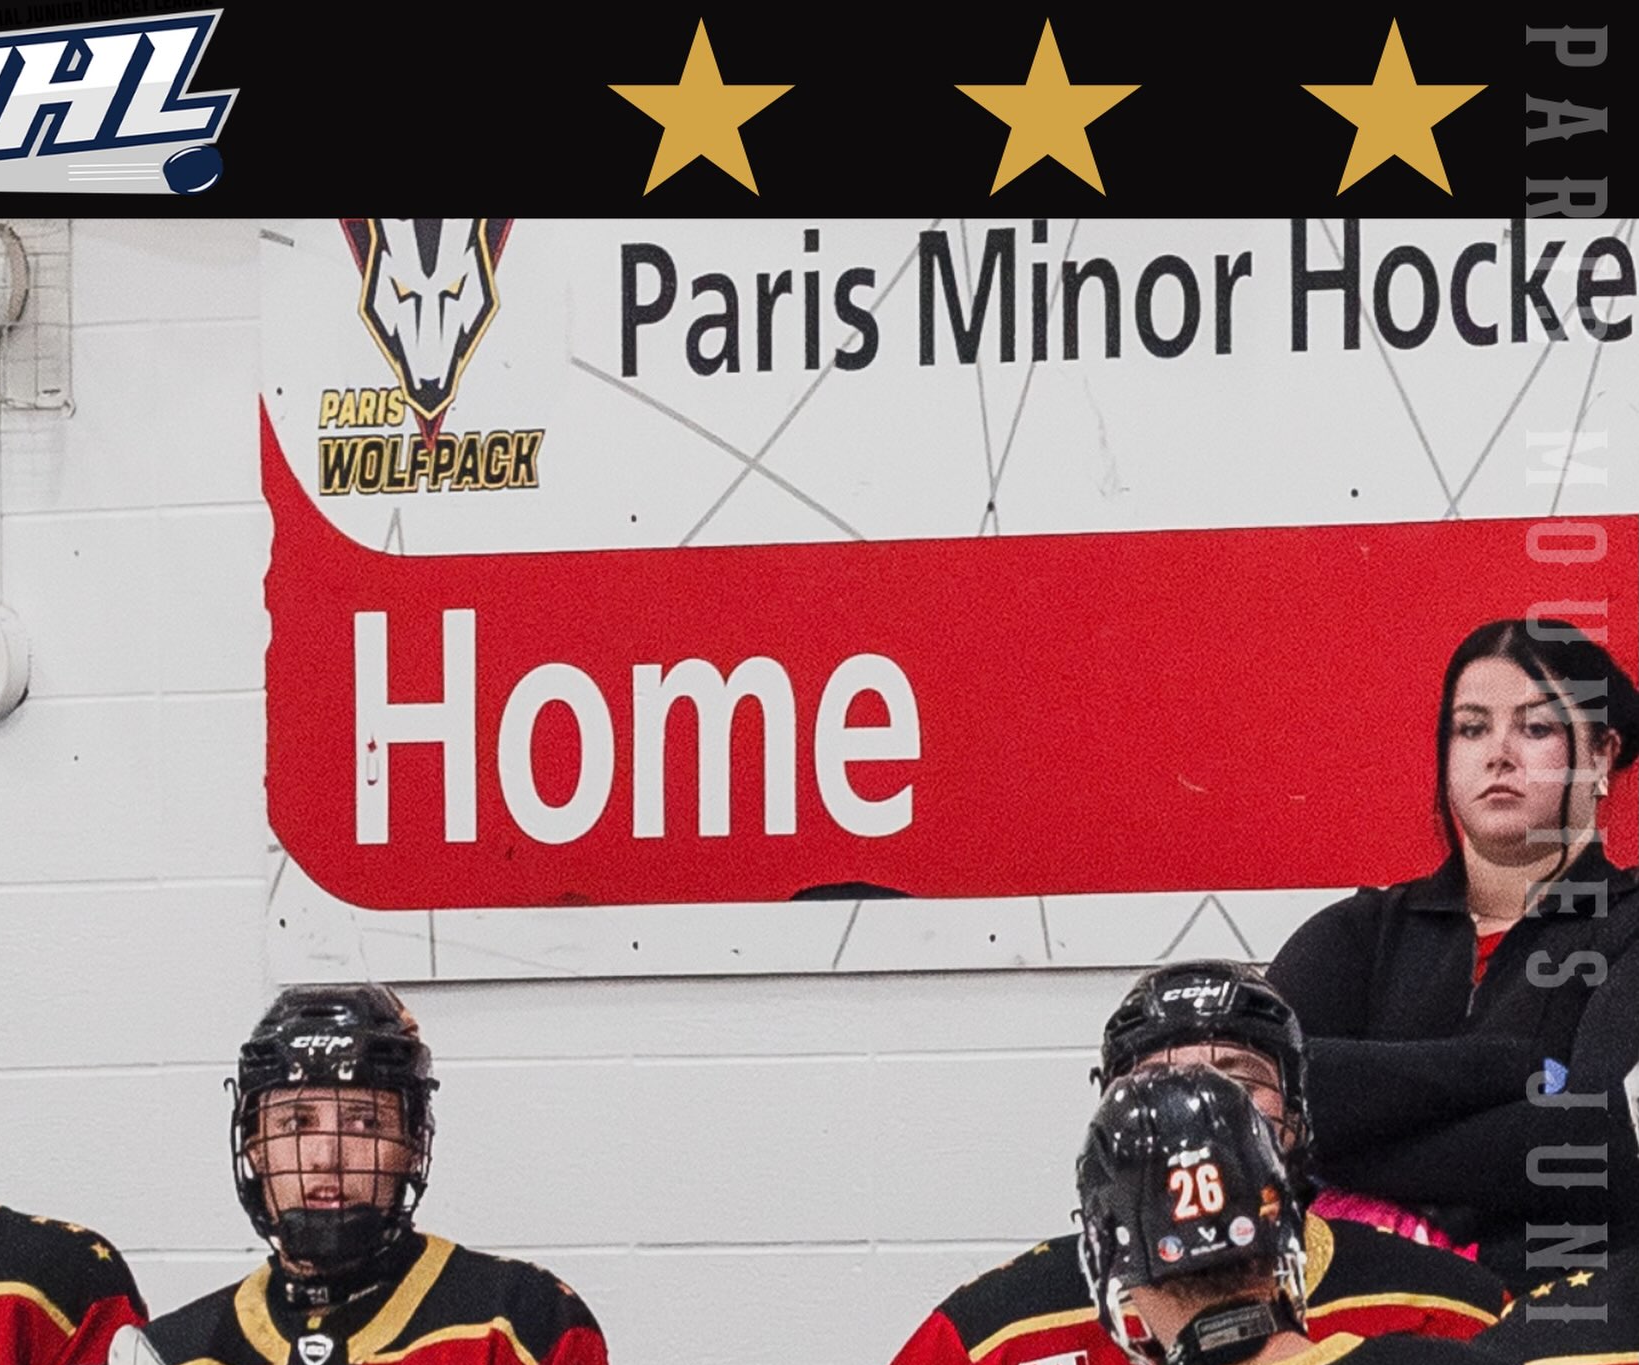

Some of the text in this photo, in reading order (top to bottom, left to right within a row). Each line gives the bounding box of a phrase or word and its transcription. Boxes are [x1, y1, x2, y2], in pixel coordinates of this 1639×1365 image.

[620, 228, 880, 379] Paris
[918, 219, 1252, 367] Minor
[318, 389, 406, 429] PARIS
[317, 429, 545, 496] WOLFPACK
[354, 607, 922, 846] Home
[1169, 1162, 1225, 1220] 26
